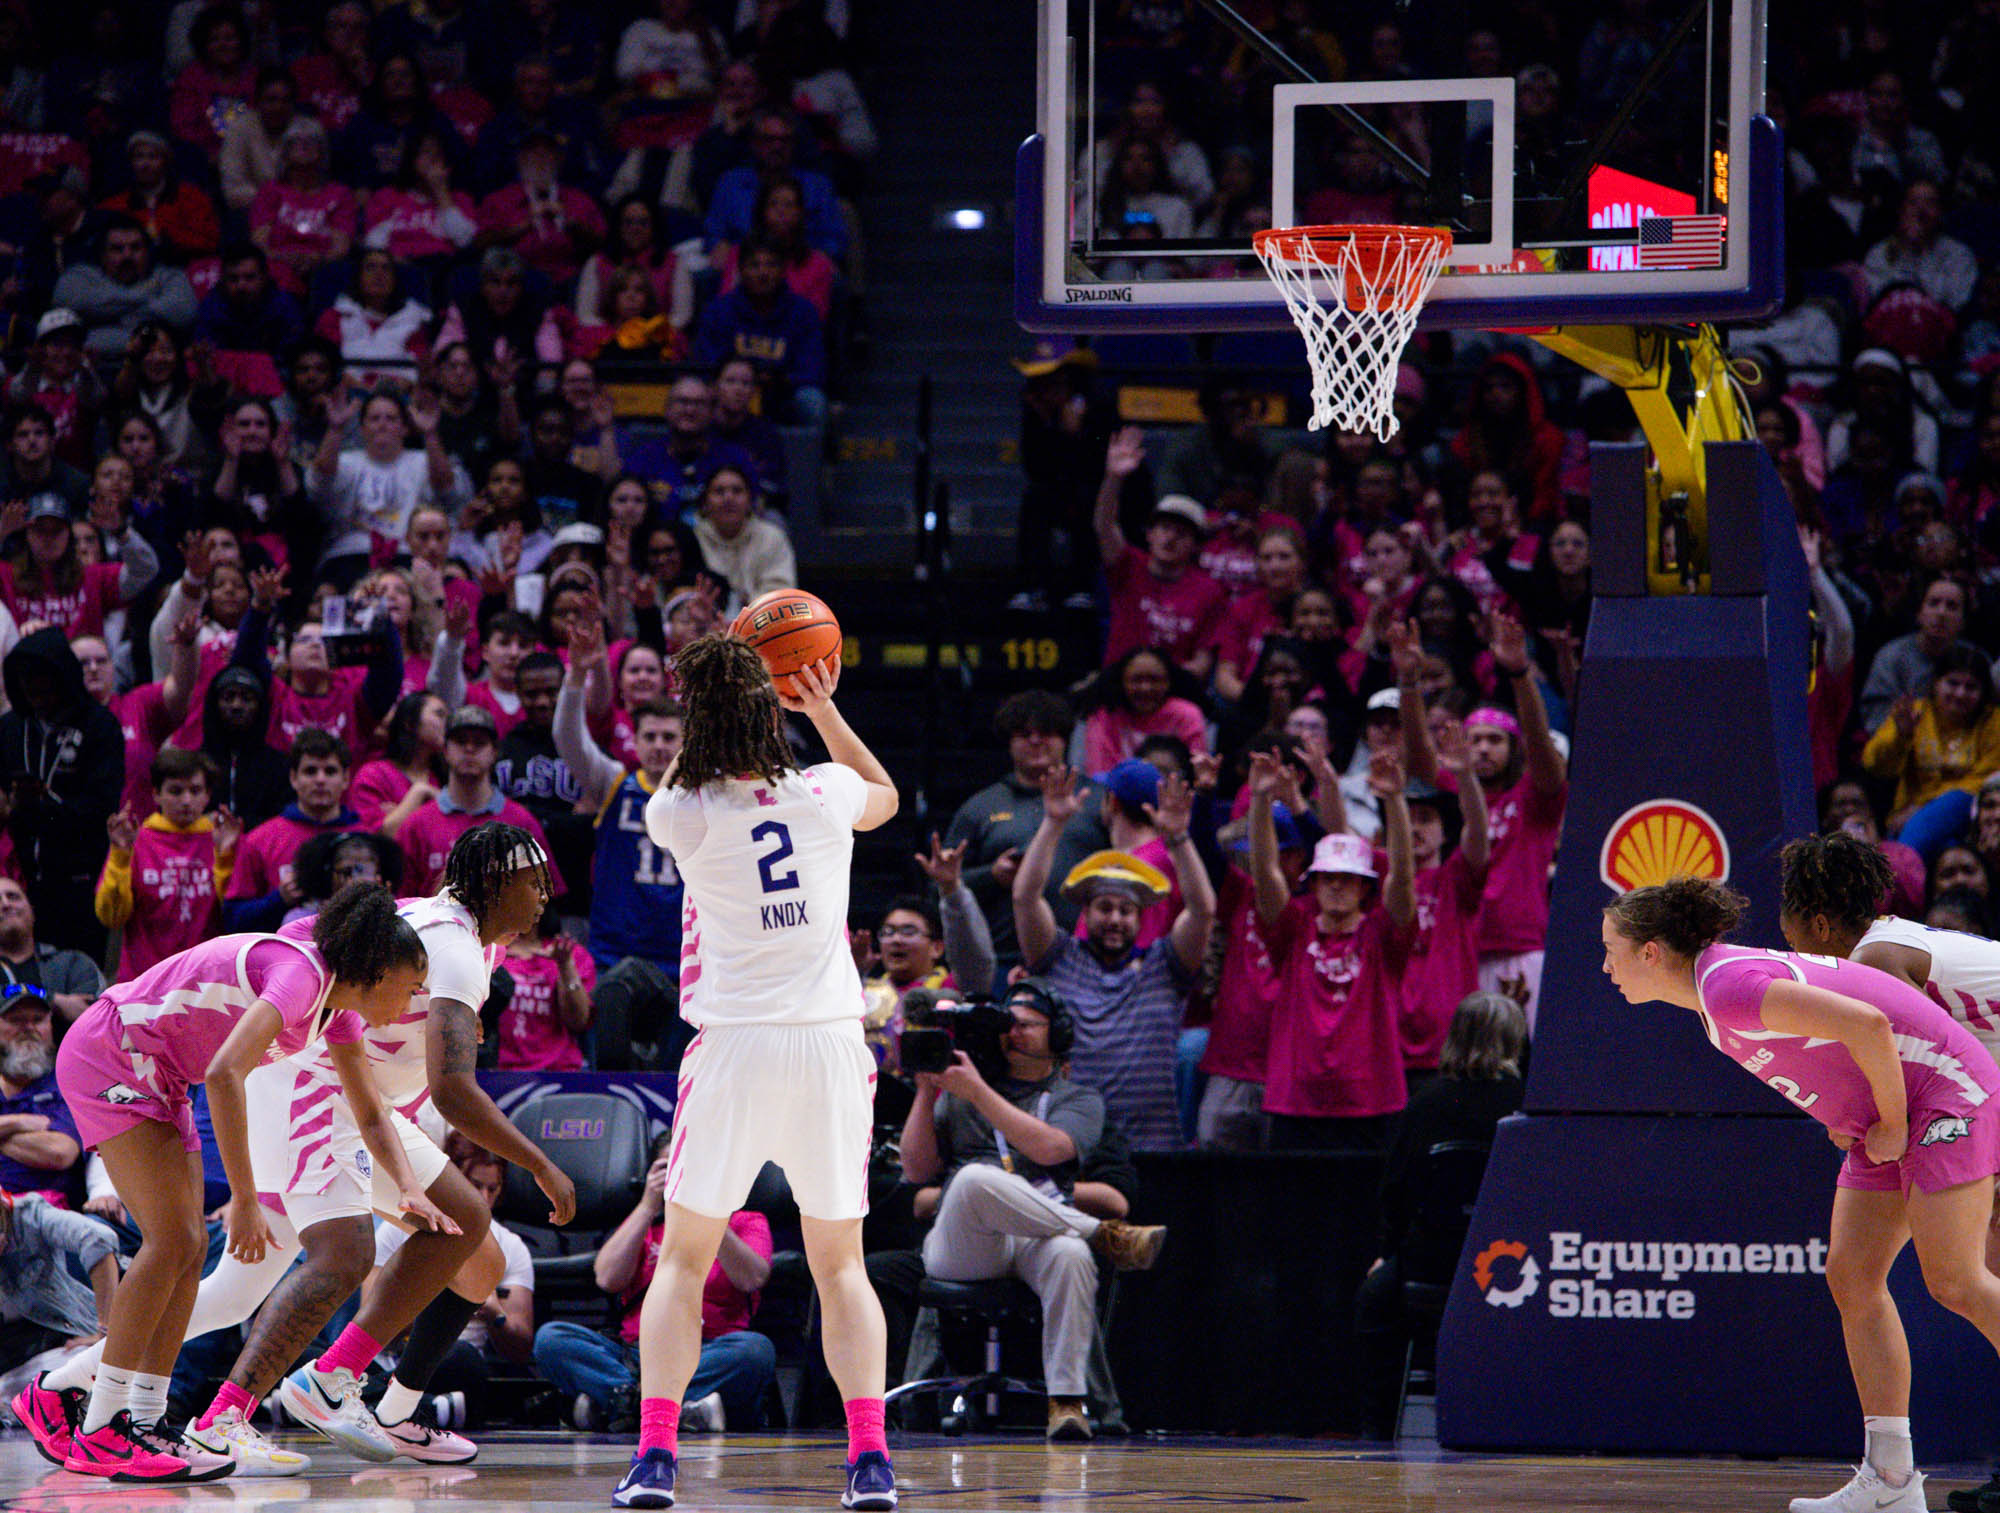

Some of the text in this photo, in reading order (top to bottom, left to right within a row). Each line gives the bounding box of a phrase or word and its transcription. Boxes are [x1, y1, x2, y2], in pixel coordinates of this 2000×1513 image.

[1065, 287, 1132, 303] SPALDING
[1002, 638, 1059, 670] 119
[496, 754, 580, 801] LSU
[635, 837, 678, 885] 11
[751, 820, 800, 893] 2
[760, 900, 808, 930] KNOX
[541, 1118, 604, 1139] LSU
[1550, 1232, 1827, 1281] Equipment
[1550, 1279, 1696, 1319] Share
